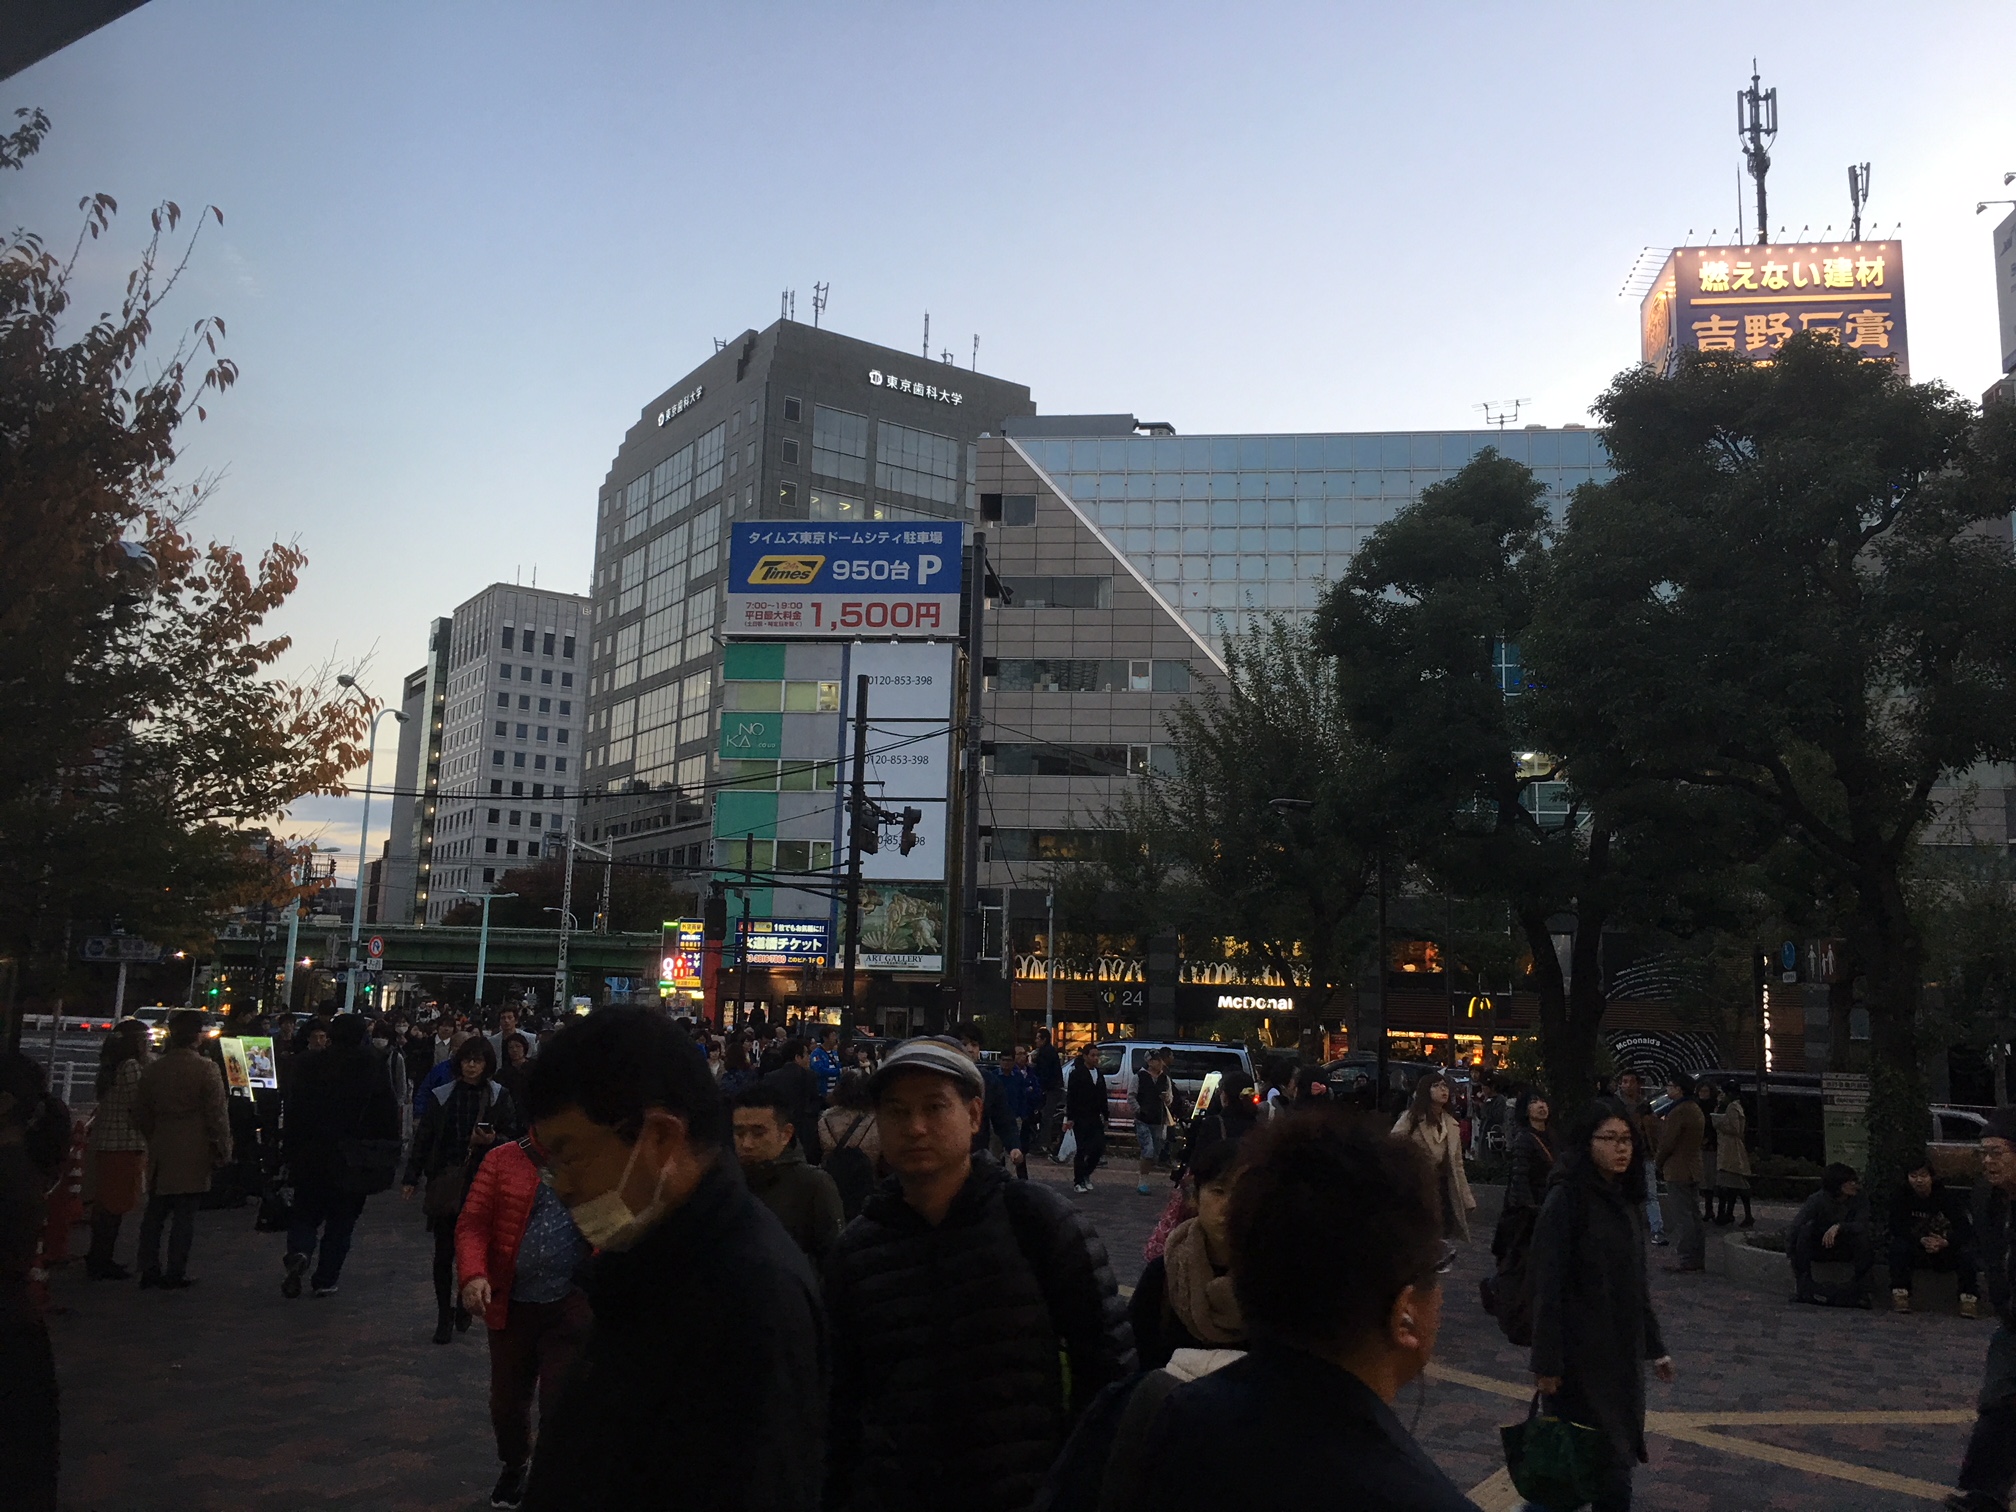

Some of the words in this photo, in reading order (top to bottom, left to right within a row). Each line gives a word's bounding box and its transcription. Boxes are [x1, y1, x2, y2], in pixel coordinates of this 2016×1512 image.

[1699, 255, 1886, 293] 燃えない建材
[886, 374, 963, 407] 東京歯科大学
[665, 385, 704, 422] 東京歯科大学
[748, 530, 944, 545] タイムズ東京ドームシティ駐車場
[760, 561, 815, 581] Times
[832, 559, 911, 581] 950台
[917, 554, 943, 585] P
[745, 611, 802, 621] 平日最大料金
[810, 602, 941, 631] 1,500円
[868, 675, 933, 686] 0120-853-398
[739, 722, 765, 736] NO
[864, 755, 929, 765] 0120-853-398
[866, 954, 882, 962] ART
[885, 954, 924, 963] GALLERY
[1122, 990, 1143, 1006] 24
[1615, 1036, 1661, 1051] McDonald's
